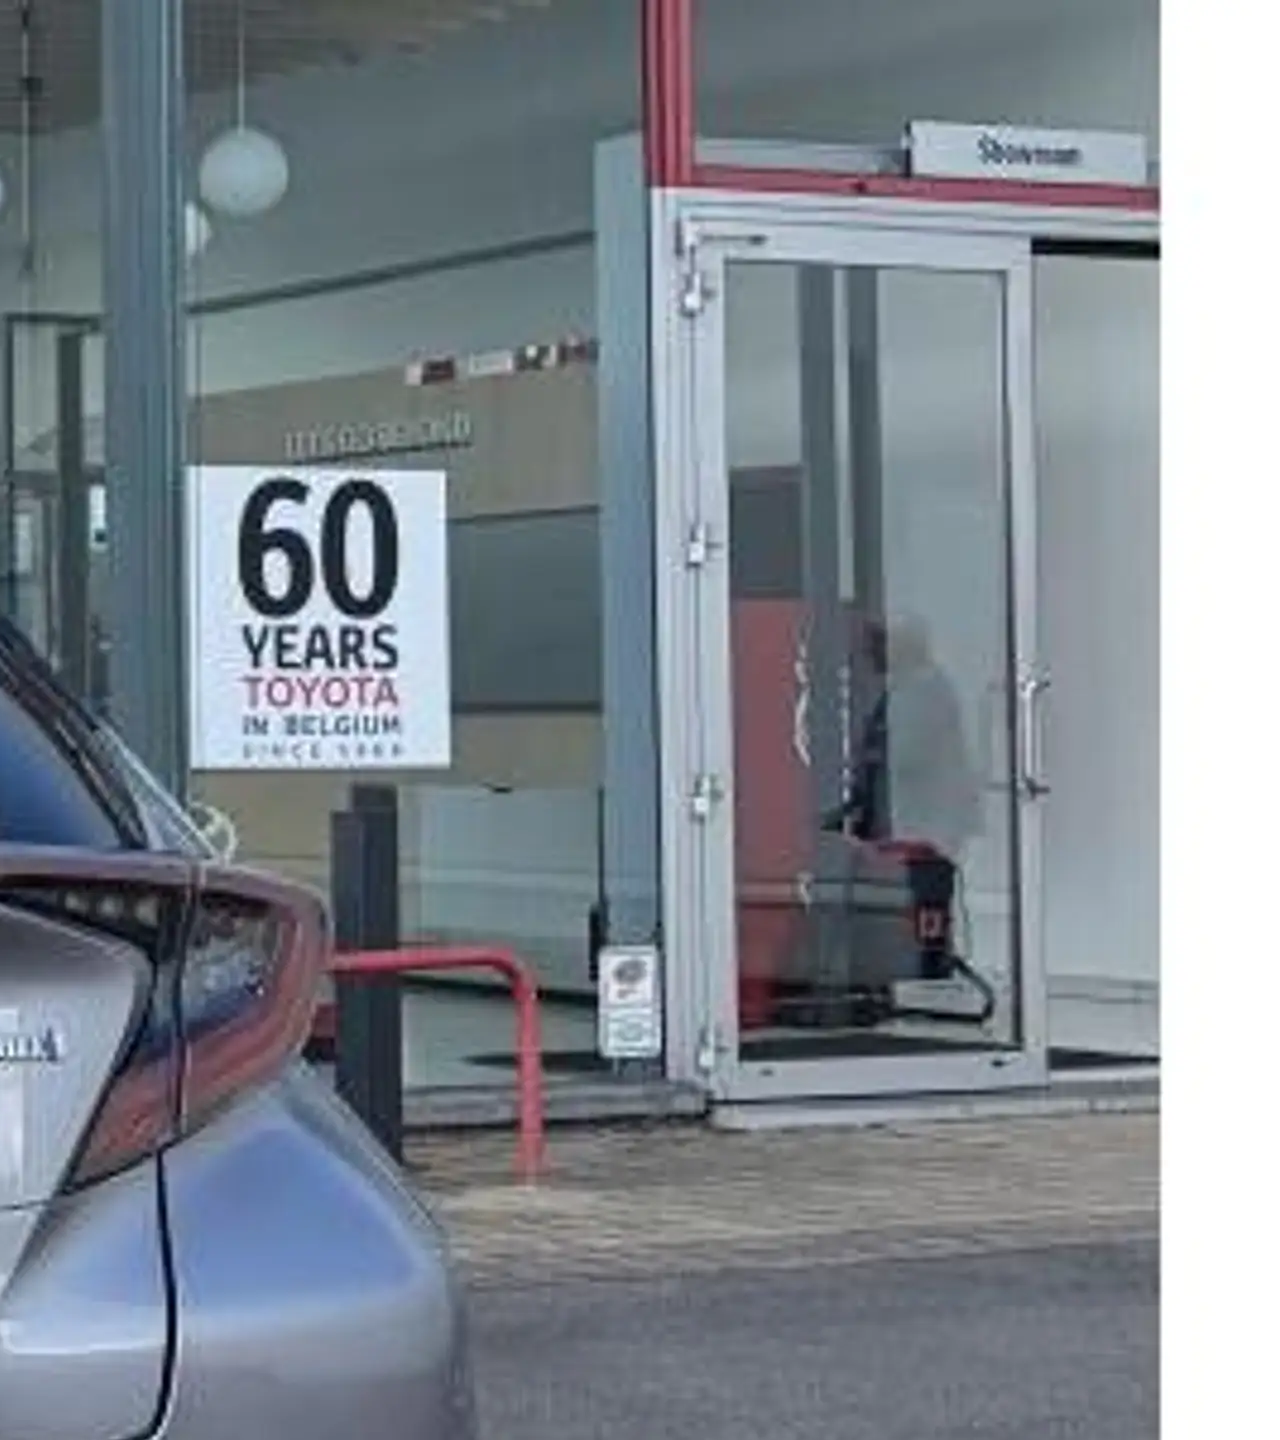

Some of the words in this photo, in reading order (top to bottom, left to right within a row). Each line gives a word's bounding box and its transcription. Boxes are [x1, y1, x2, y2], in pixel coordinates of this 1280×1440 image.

[237, 477, 400, 620] 60
[241, 623, 400, 671] YEARS
[240, 675, 400, 709] TOYOTA
[241, 713, 270, 736] IN
[284, 712, 403, 736] BELGIUM
